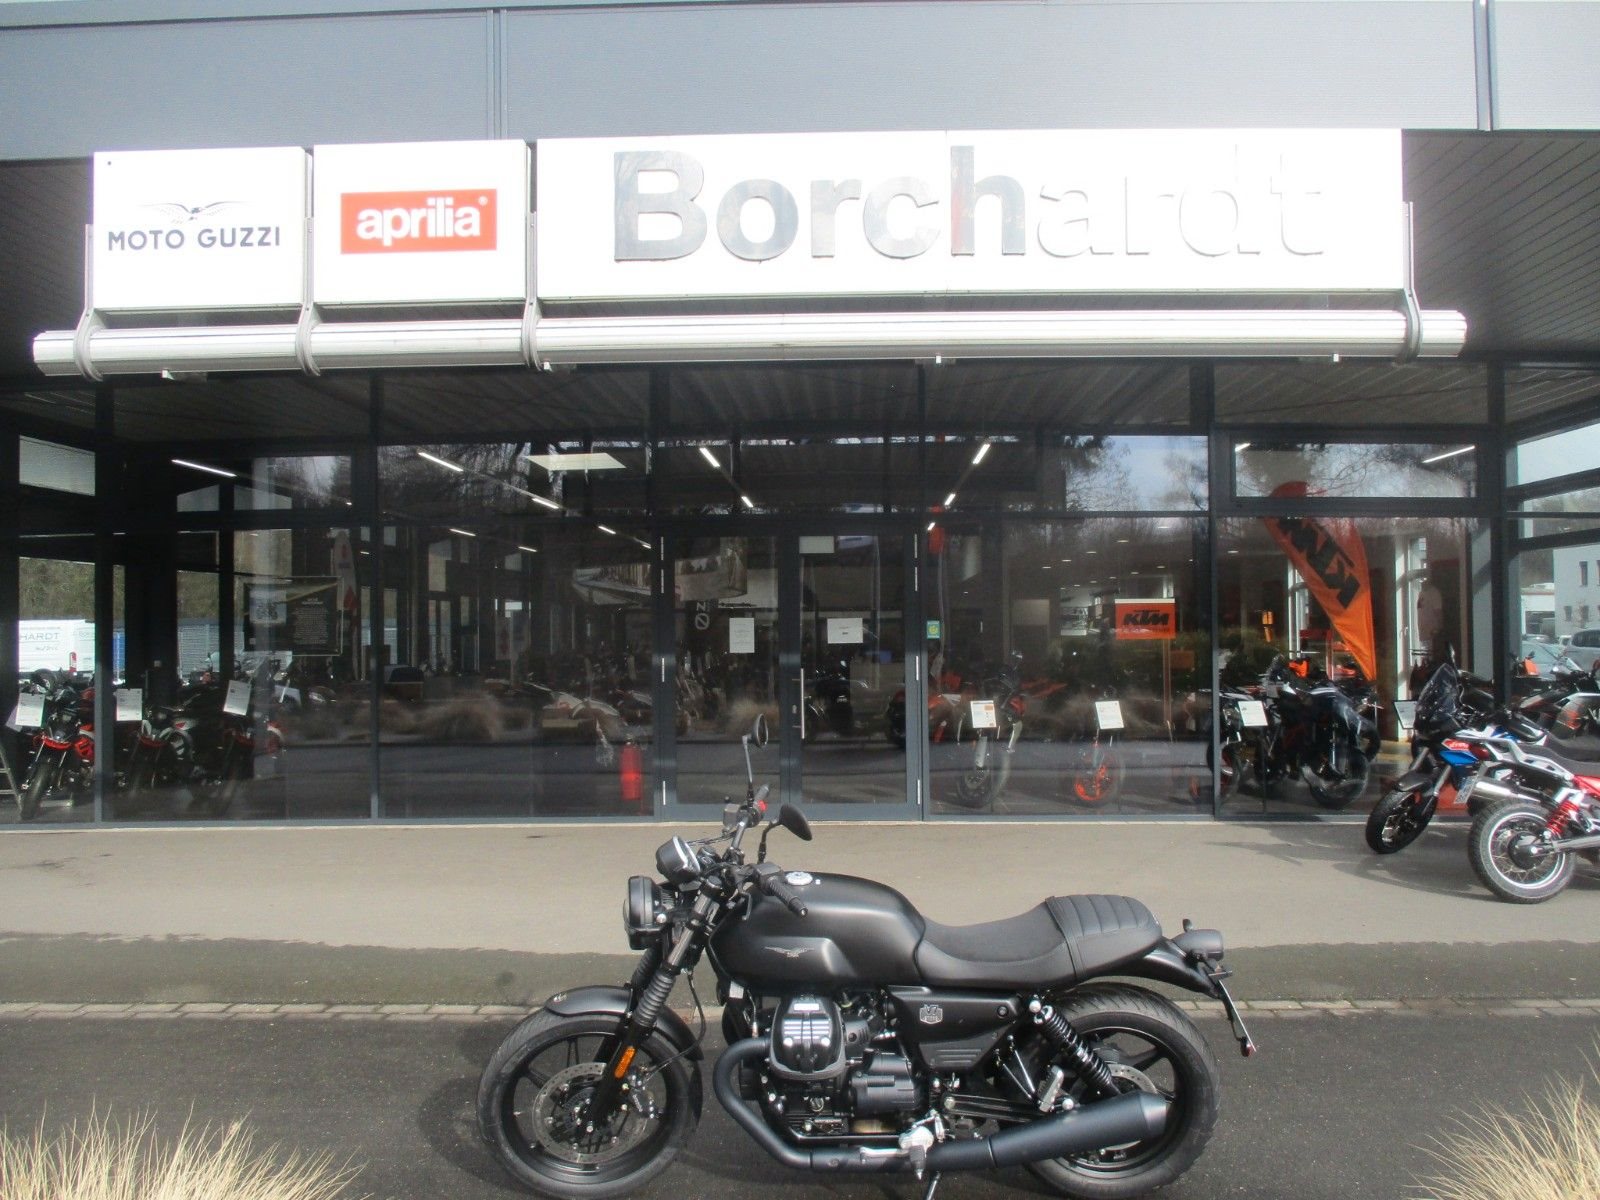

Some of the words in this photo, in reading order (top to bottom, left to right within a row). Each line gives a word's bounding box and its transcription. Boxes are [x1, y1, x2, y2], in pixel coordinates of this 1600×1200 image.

[613, 145, 1325, 261] Borchardt
[108, 229, 186, 251] MOTO
[197, 226, 281, 248] GUZZI
[1123, 609, 1170, 625] KTM
